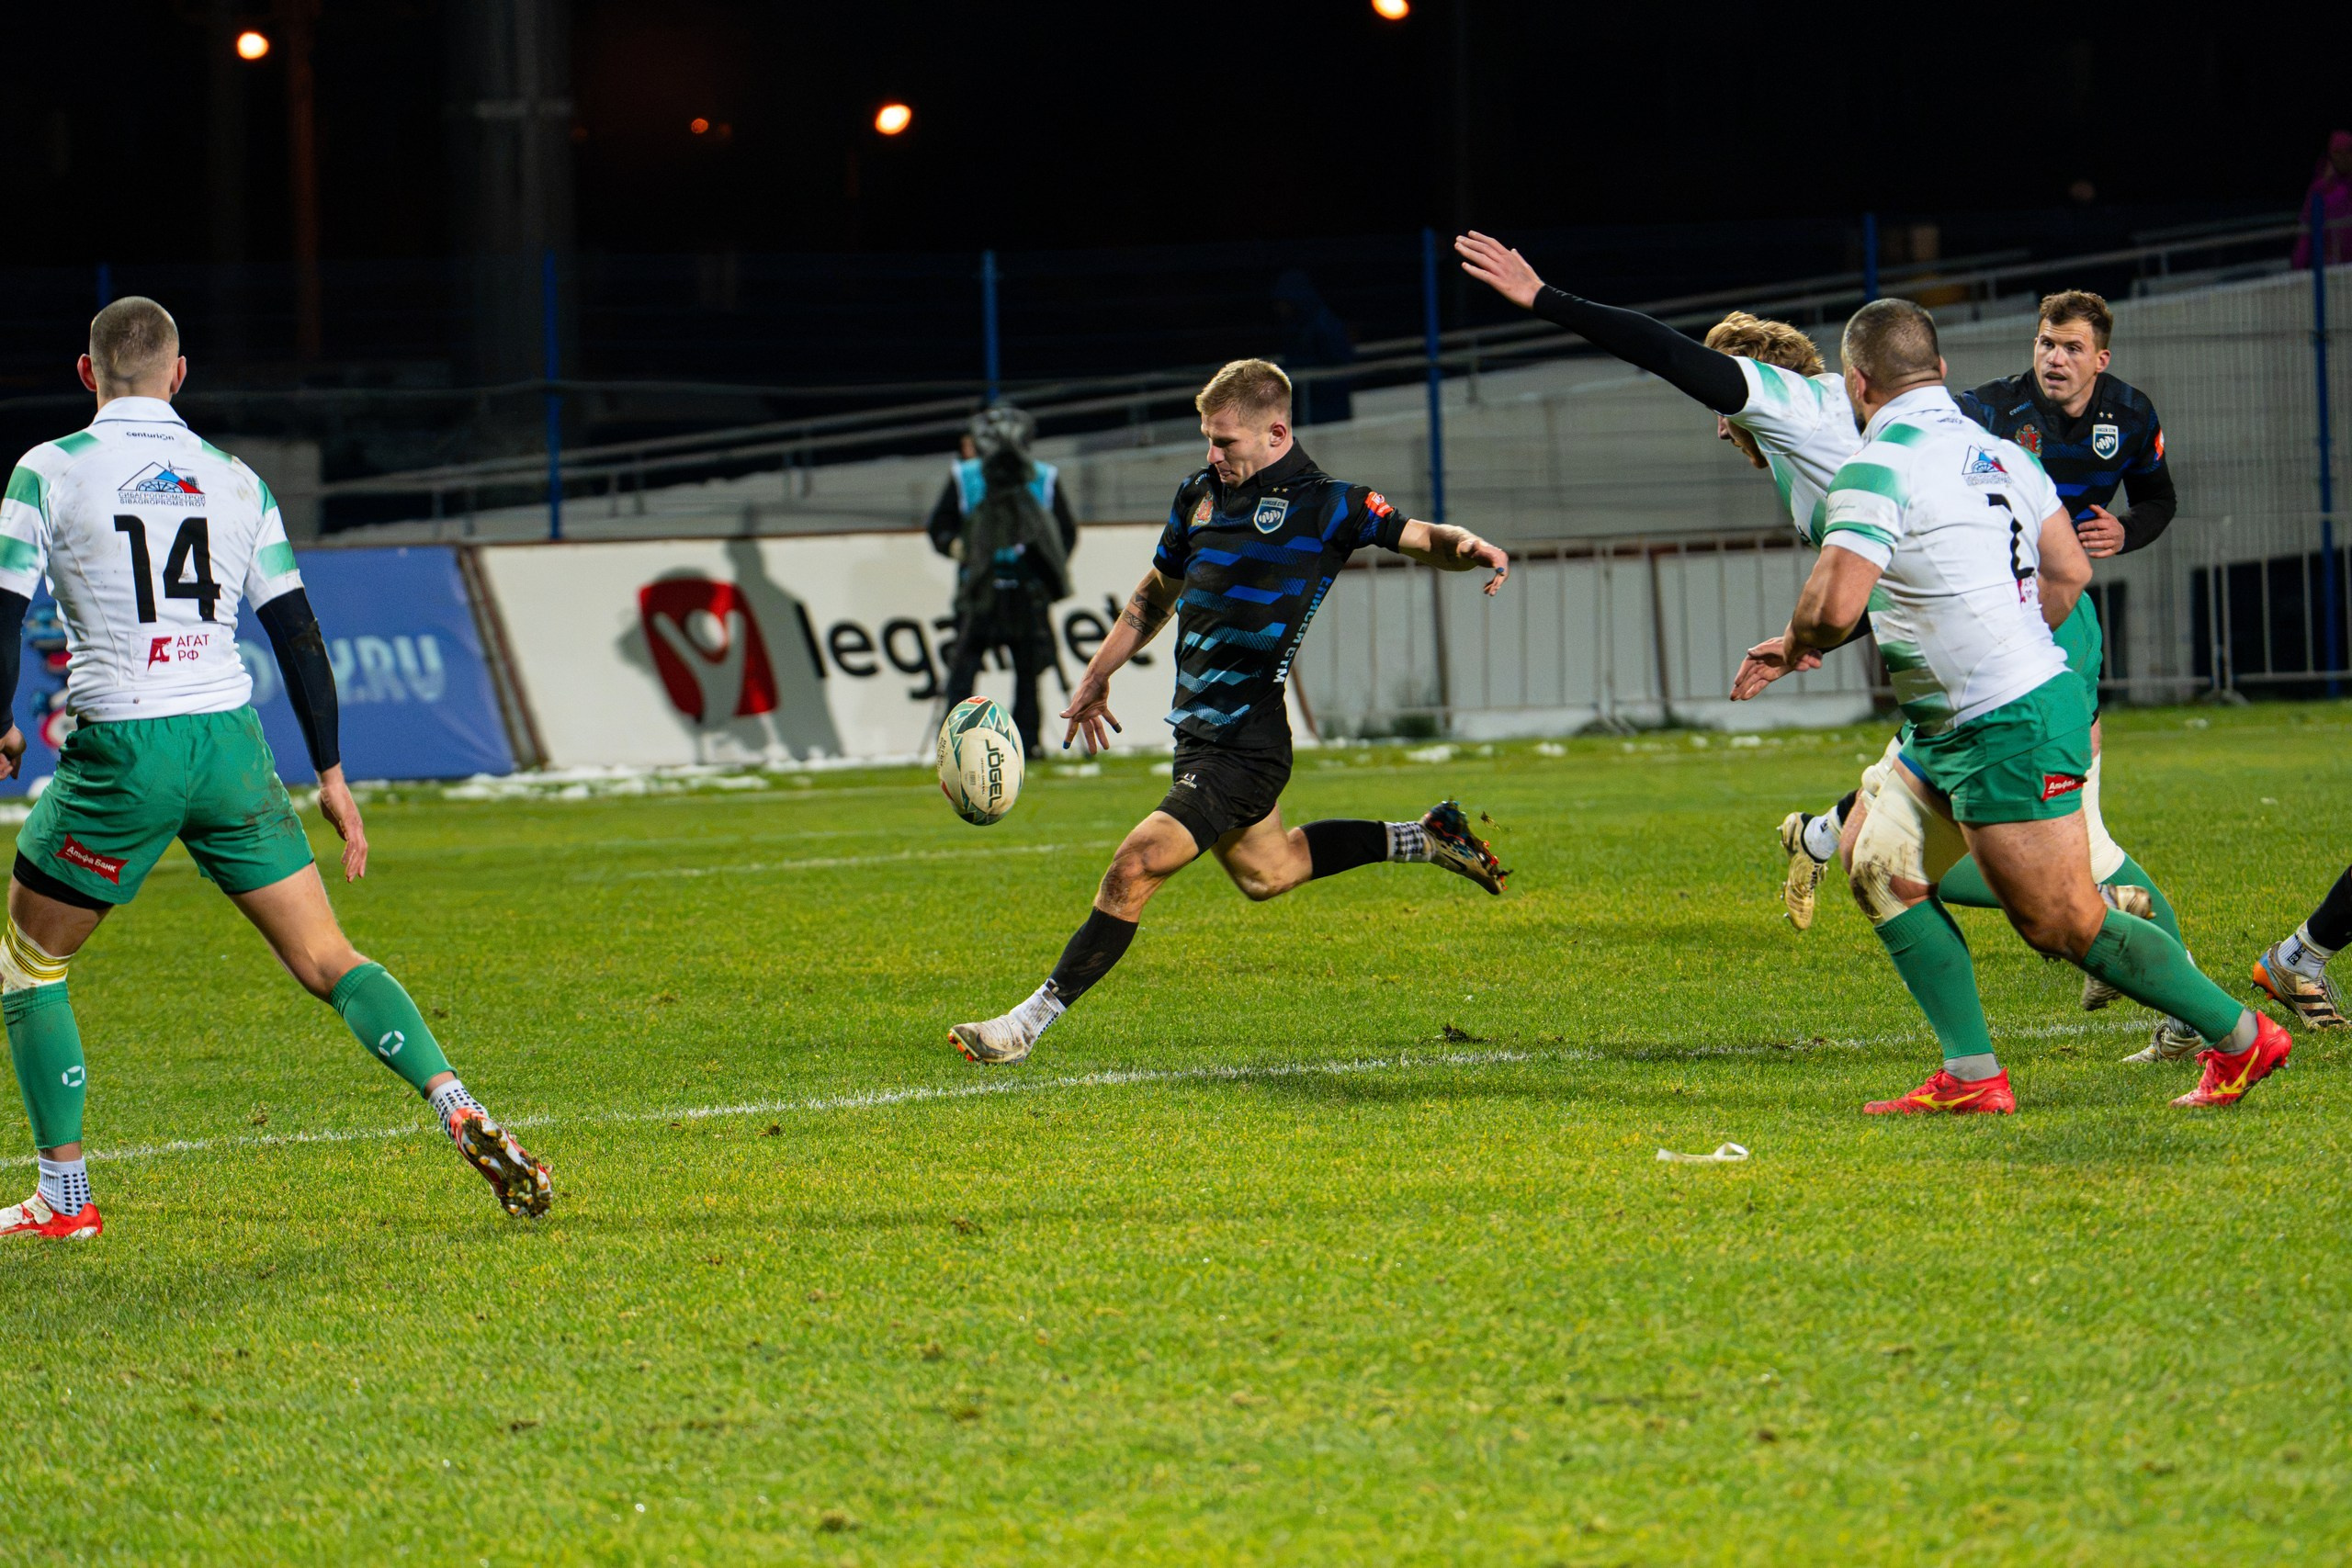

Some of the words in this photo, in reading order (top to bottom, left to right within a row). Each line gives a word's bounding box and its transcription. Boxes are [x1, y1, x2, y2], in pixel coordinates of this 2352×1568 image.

[126, 431, 175, 441] centurion
[118, 491, 206, 502] СИБАГРОПРОМСТРОЙ
[119, 499, 207, 507] SIBAGROPROMSTROY
[113, 513, 221, 624] 14
[176, 634, 209, 648] АГАТ
[177, 649, 199, 661] РФ
[985, 739, 1004, 808] JÖGEL
[66, 846, 94, 864] Альфа
[94, 858, 117, 873] Банк
